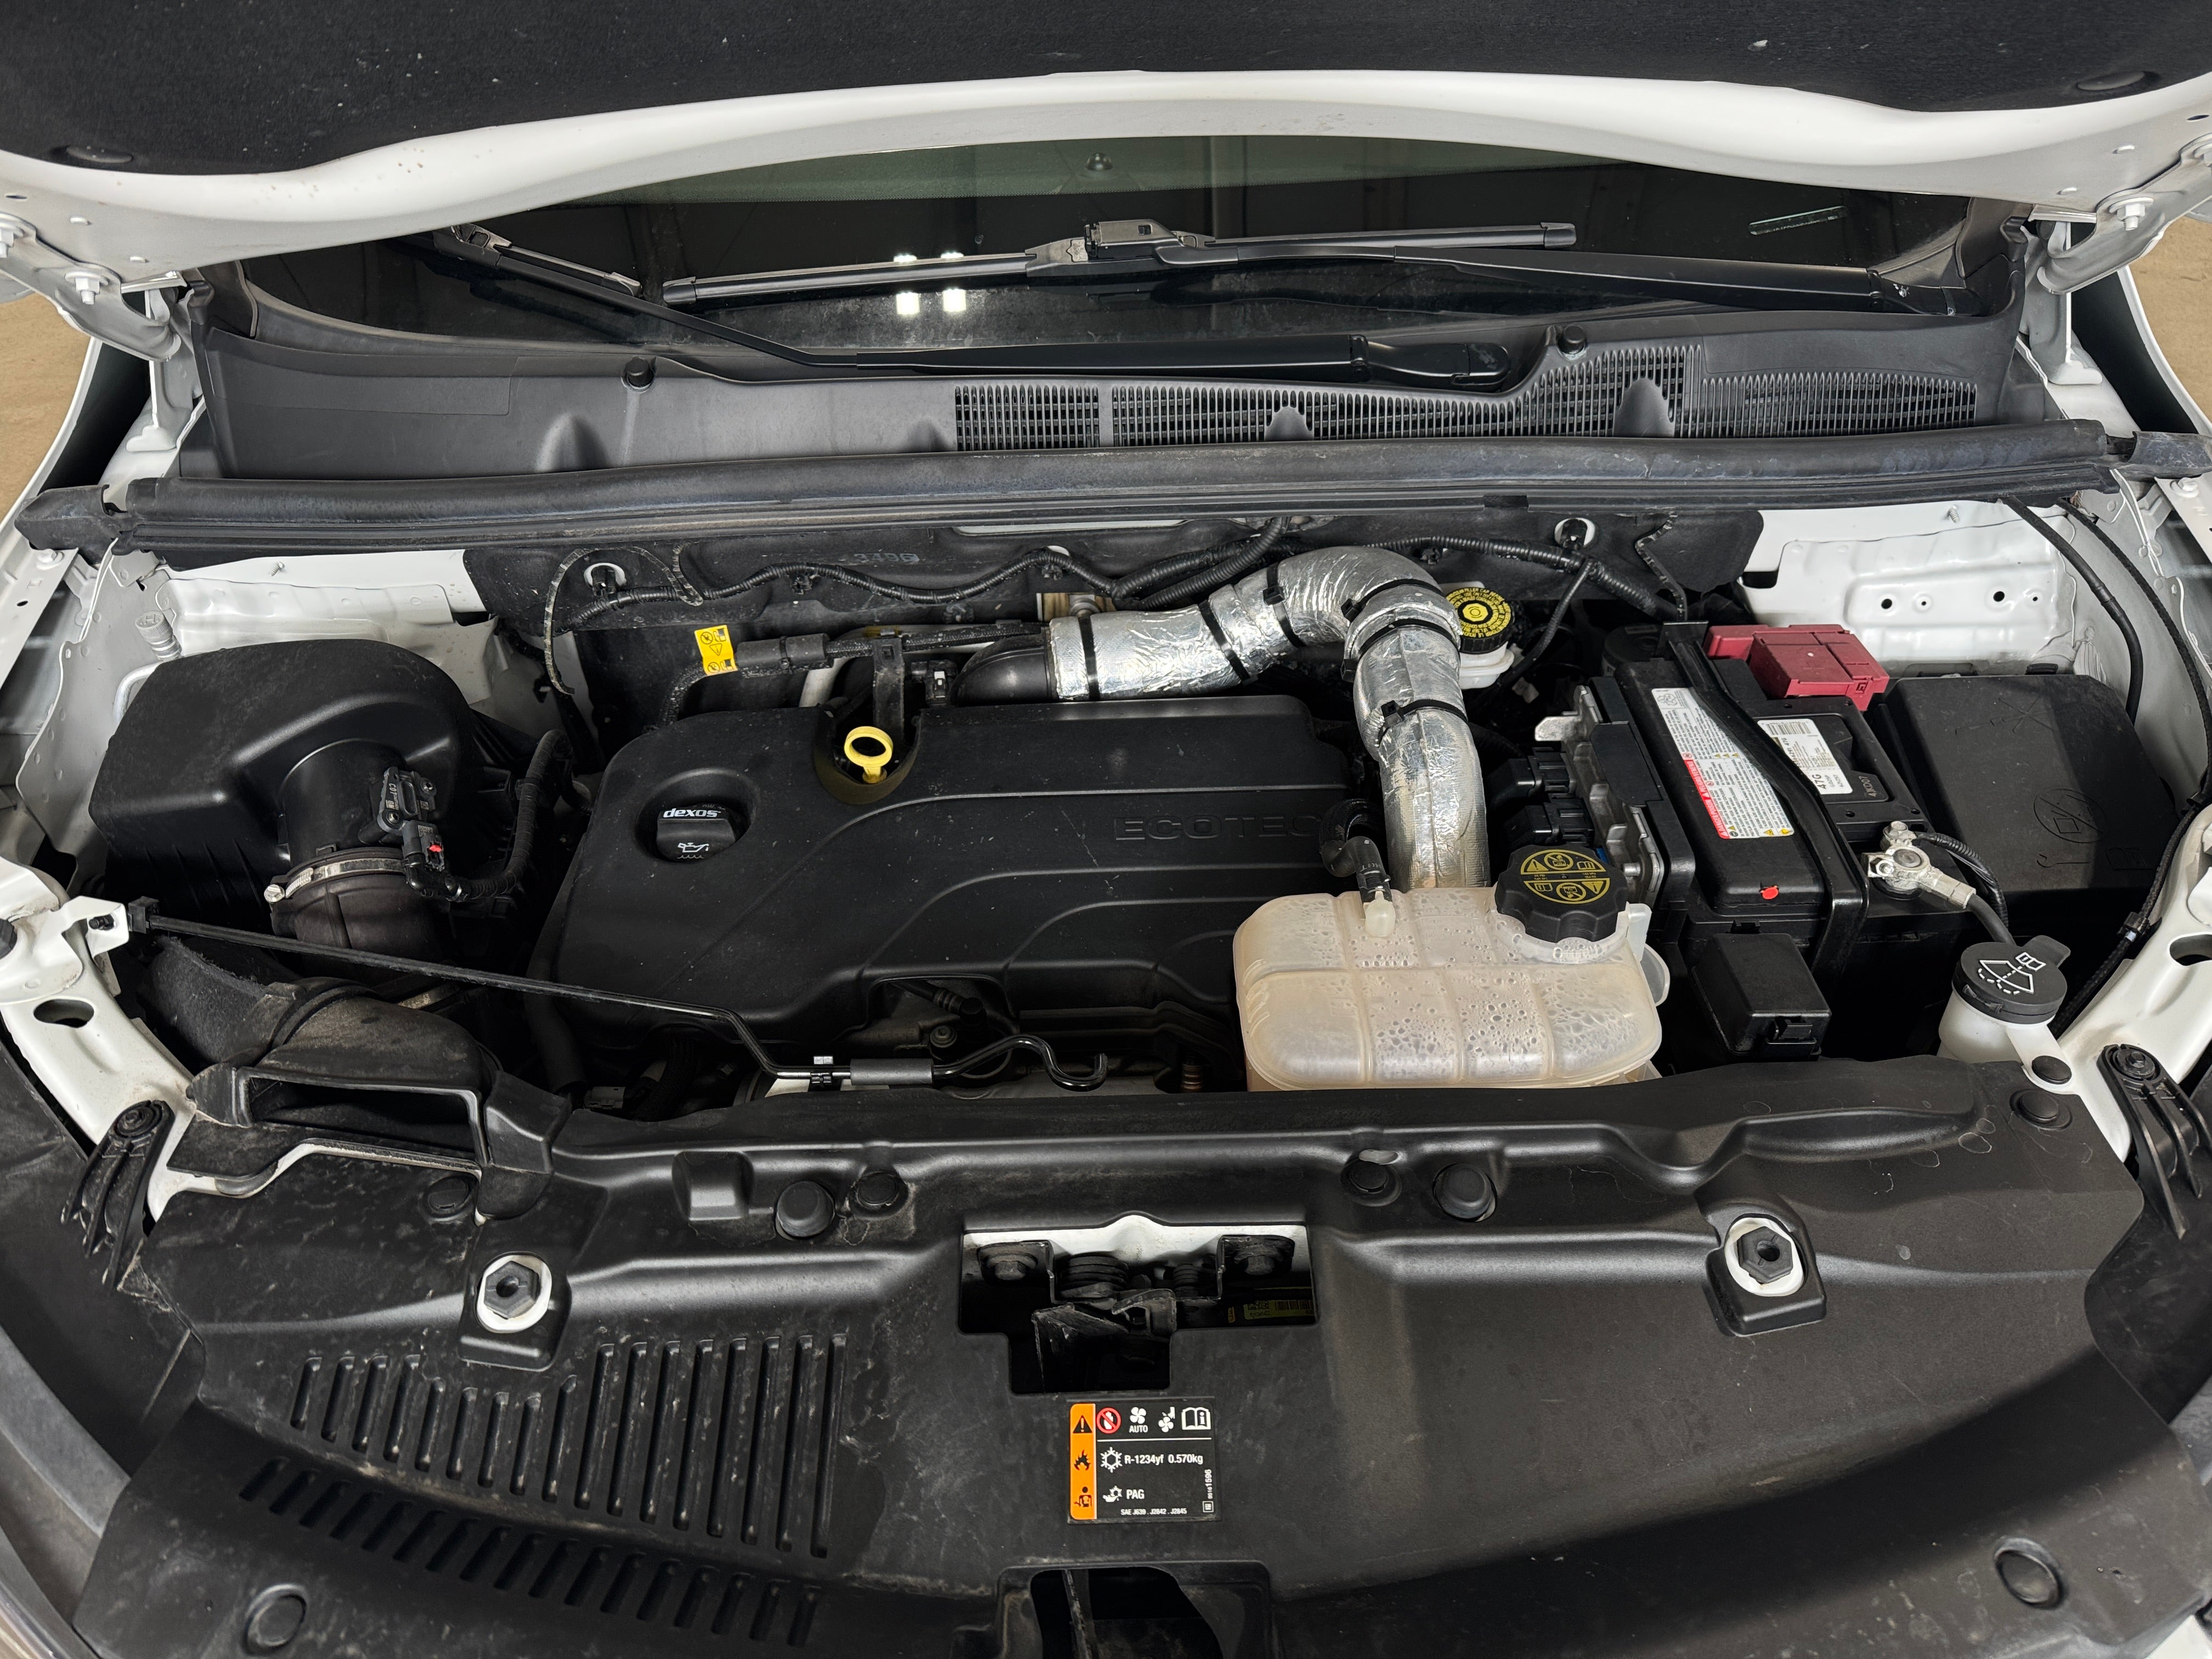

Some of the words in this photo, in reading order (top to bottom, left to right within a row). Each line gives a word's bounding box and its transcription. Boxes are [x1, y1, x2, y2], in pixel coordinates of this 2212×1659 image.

[1812, 774, 1826, 789] 47G
[663, 808, 718, 817] dexos
[1114, 814, 1318, 840] ECOTEC
[1125, 1455, 1164, 1465] R-1234yf
[1168, 1454, 1203, 1465] 0.570kg
[1126, 1489, 1145, 1499] PAG
